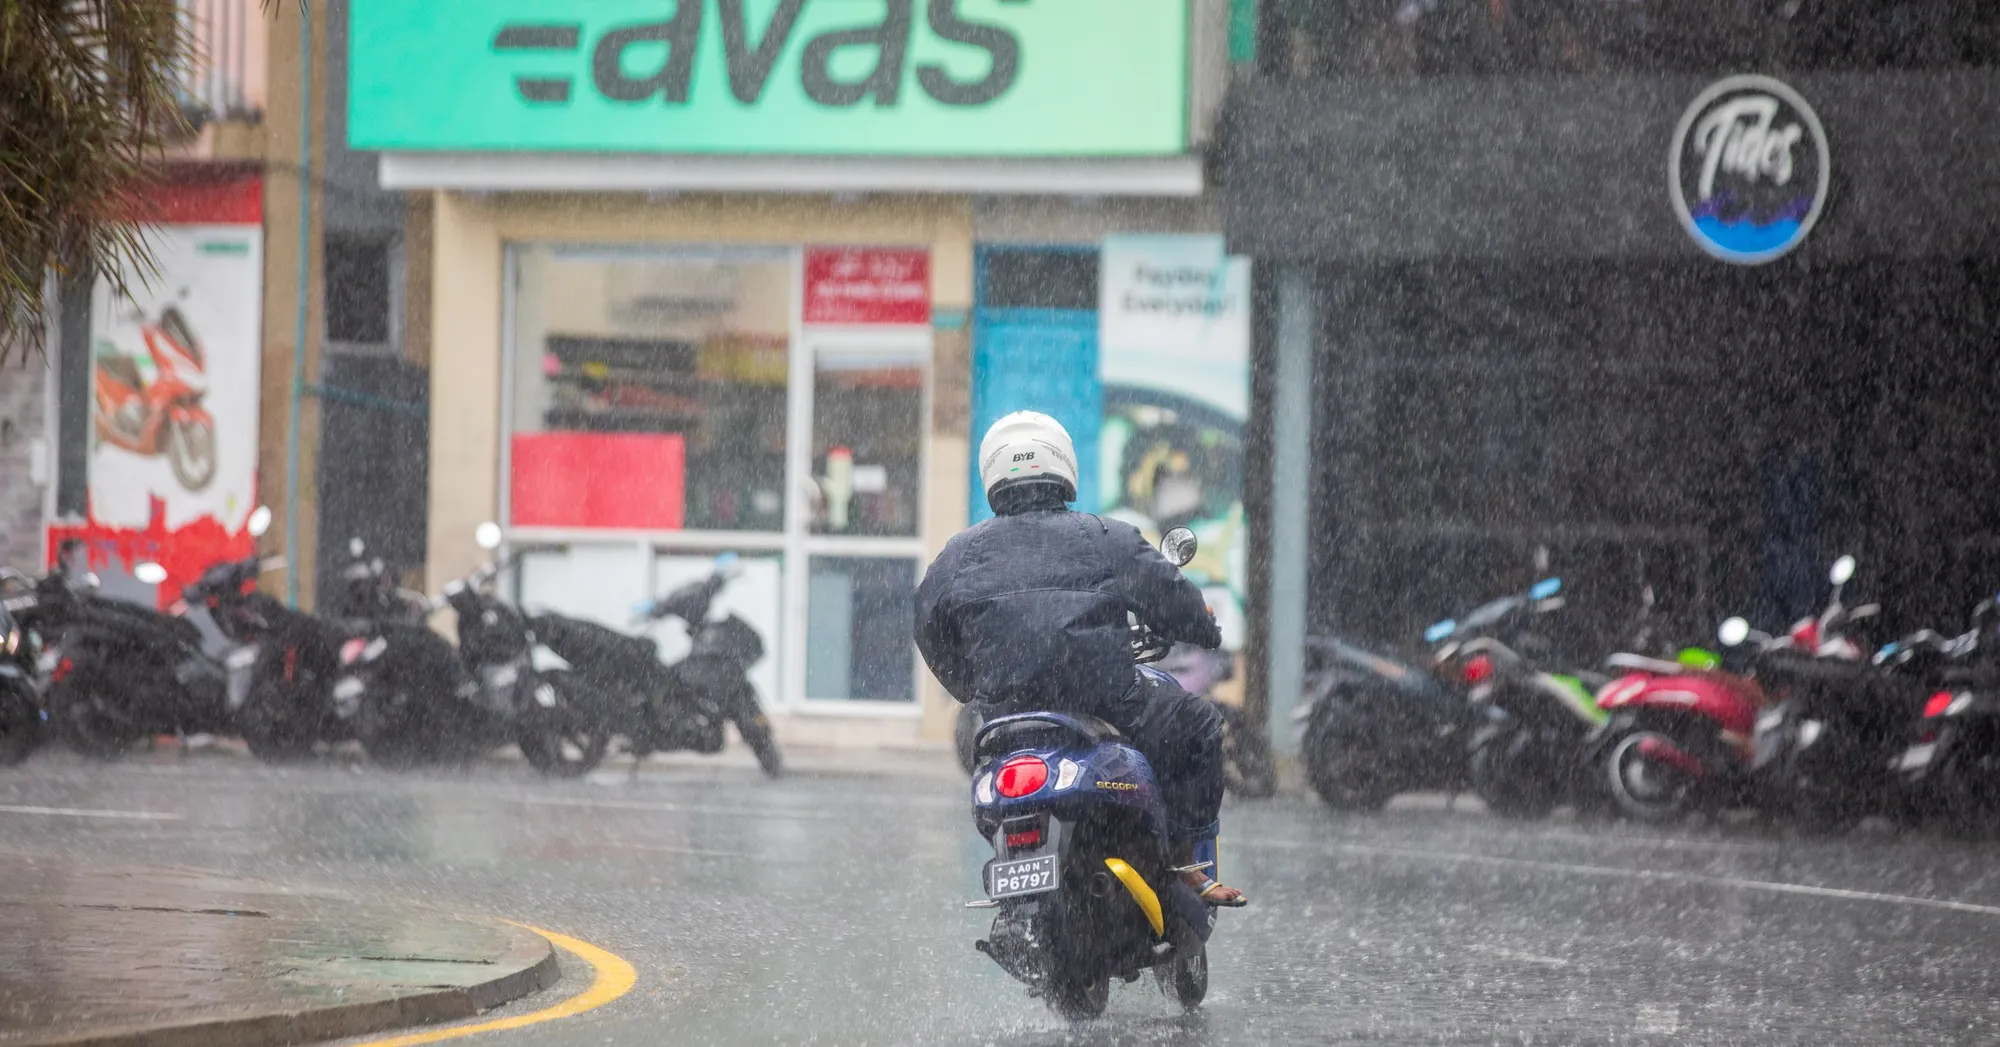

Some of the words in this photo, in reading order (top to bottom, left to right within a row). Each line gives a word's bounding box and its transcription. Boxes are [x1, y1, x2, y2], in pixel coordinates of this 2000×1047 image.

[1694, 95, 1802, 201] Tides
[1012, 451, 1035, 462] BYB
[1096, 780, 1138, 791] SCOOPY
[997, 871, 1050, 893] P6797
